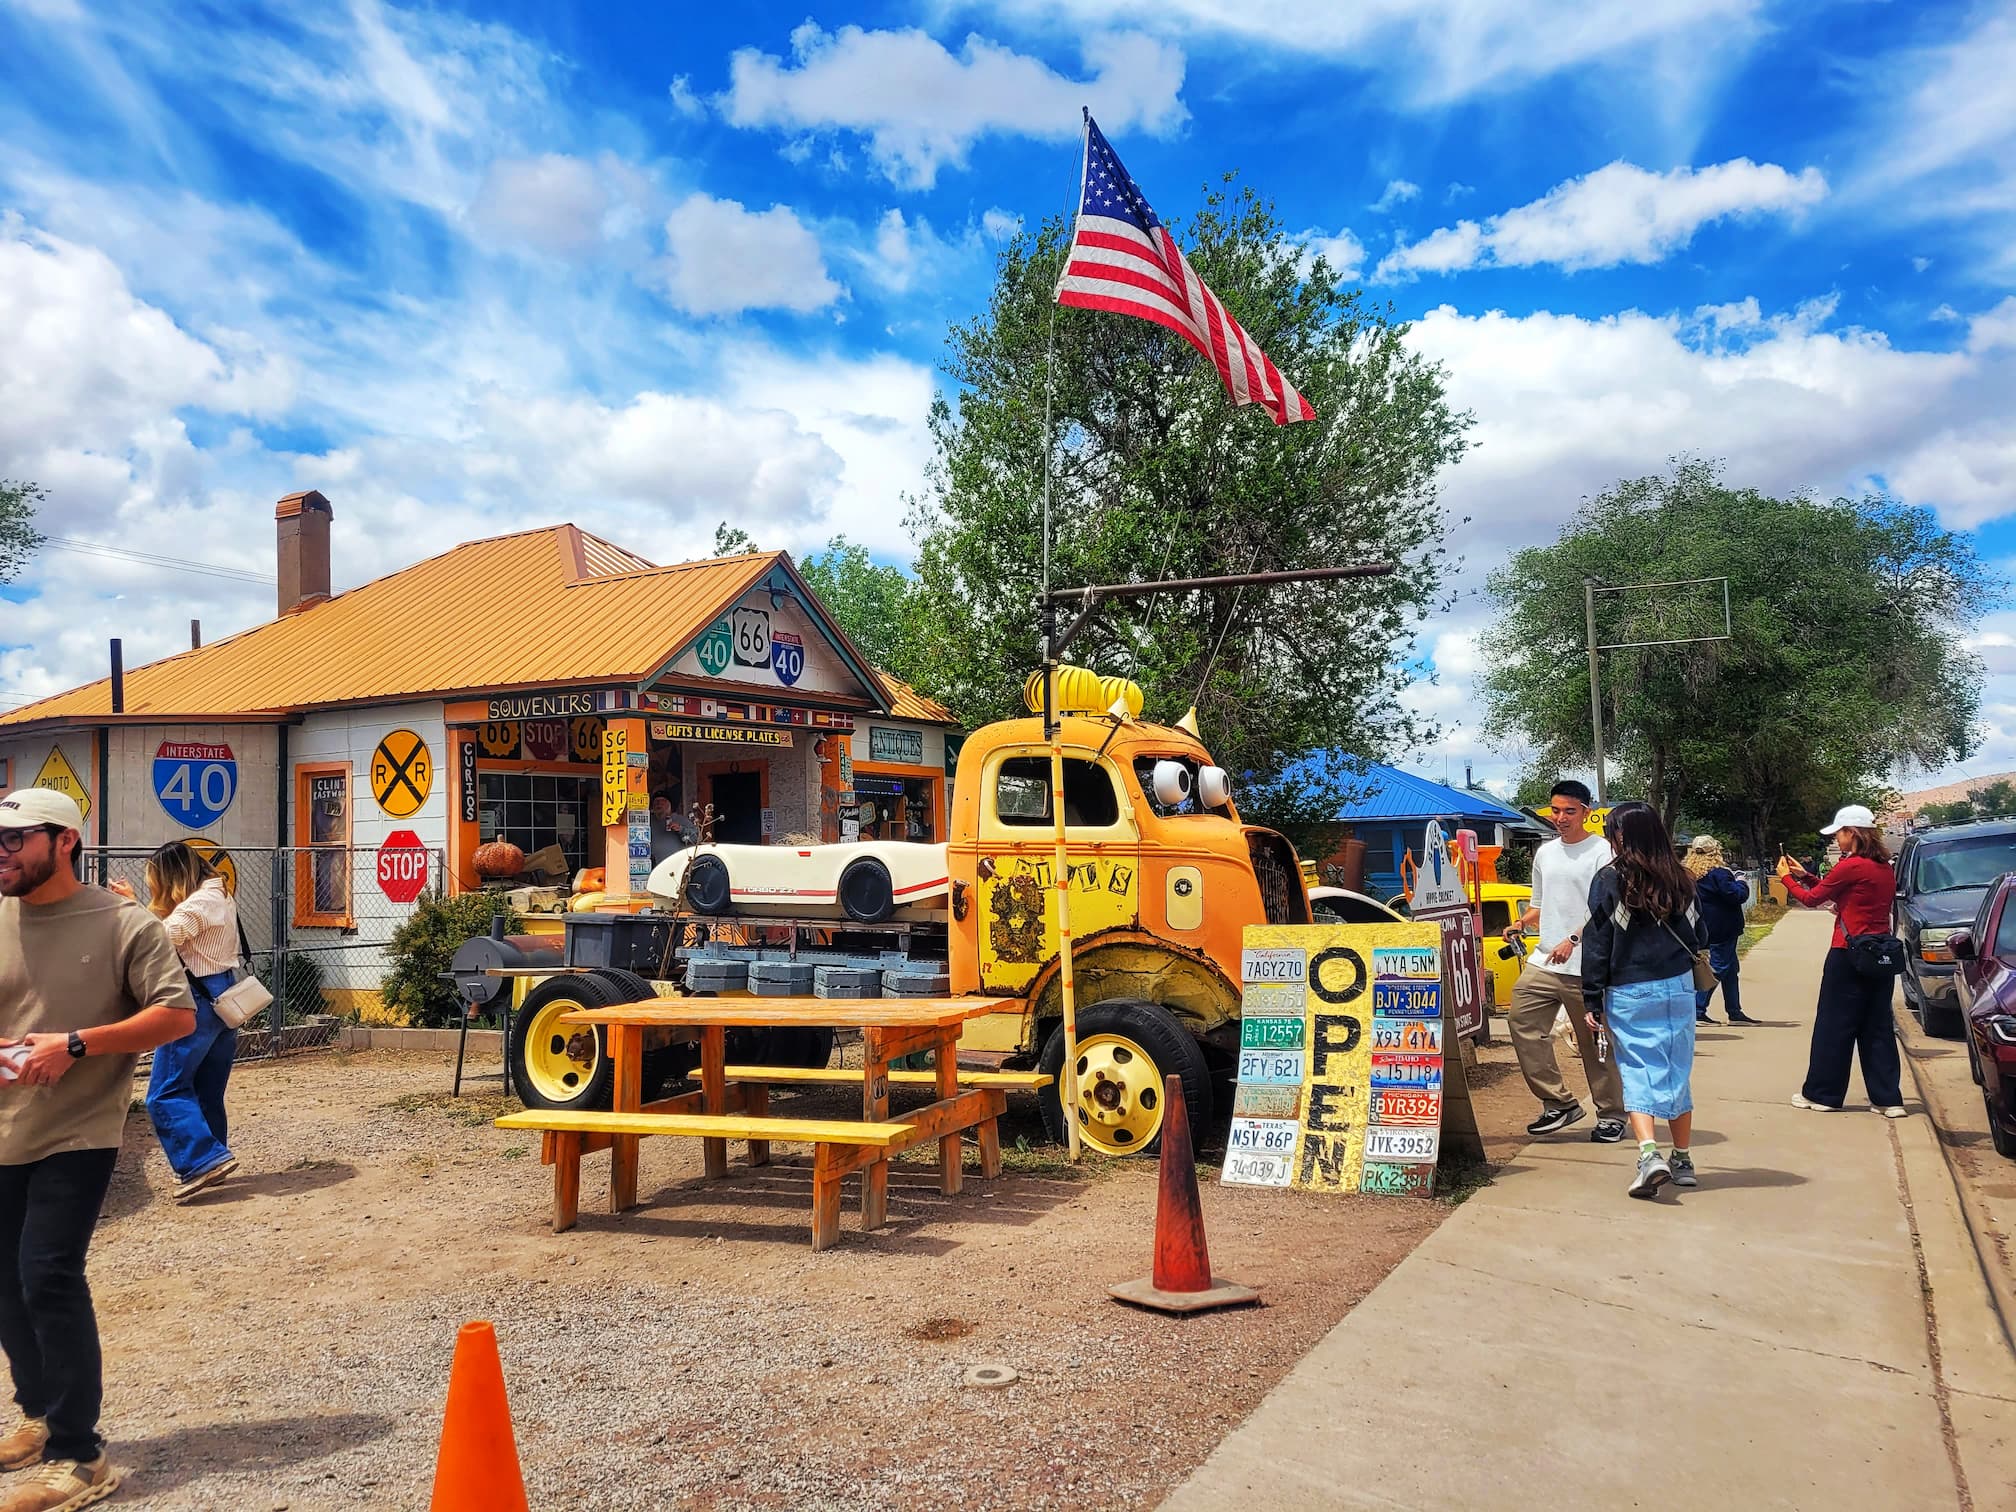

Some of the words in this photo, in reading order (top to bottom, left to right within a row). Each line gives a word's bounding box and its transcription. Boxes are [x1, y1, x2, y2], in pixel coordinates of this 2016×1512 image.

[740, 621, 764, 653] 66
[699, 638, 727, 668] 40
[775, 649, 801, 677] 40
[489, 693, 592, 719] SOUVENIRS
[487, 721, 511, 744] 66
[525, 721, 564, 744] STOP
[577, 721, 599, 750] 66
[666, 724, 693, 738] GIFTS
[695, 726, 703, 739] &
[704, 727, 745, 742] LICENSE
[746, 730, 780, 744] PLATES
[166, 745, 226, 759] INTERSTATE
[872, 731, 922, 758] ANTIQUES
[41, 776, 70, 790] PHOTO
[317, 779, 346, 791] CLINT
[375, 764, 387, 785] R
[415, 762, 426, 782] R
[462, 742, 477, 821] CURIOS
[159, 763, 232, 812] 40
[313, 791, 346, 801] EASTWOO
[379, 852, 426, 882] STOP
[1246, 961, 1302, 977] 7AGY270
[1384, 955, 1407, 973] YYA
[1411, 955, 1436, 973] 5NM
[1451, 937, 1473, 1009] 66
[1263, 1025, 1302, 1042] 12557
[1376, 1031, 1401, 1048] X93
[1410, 1031, 1436, 1049] 4YA
[1300, 946, 1367, 1187] OPEN
[1376, 1098, 1438, 1115] BYR396
[1368, 1136, 1434, 1154] JVK-3952
